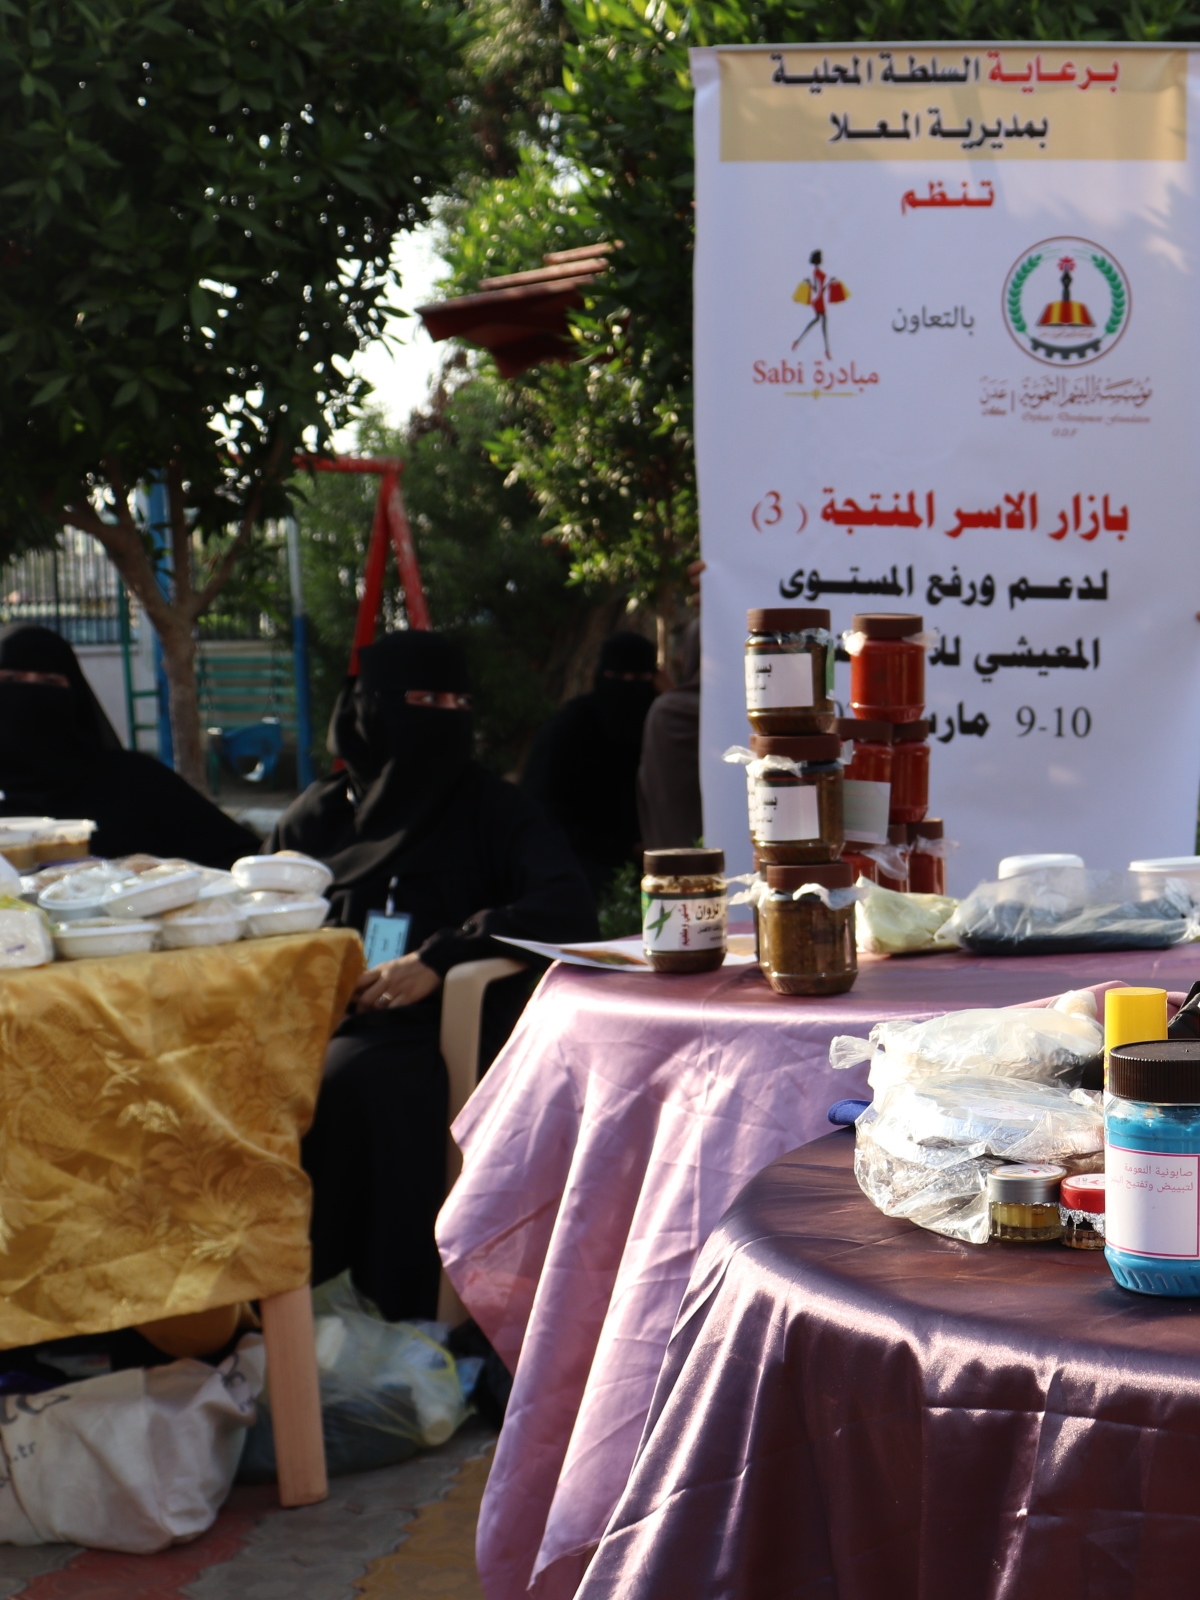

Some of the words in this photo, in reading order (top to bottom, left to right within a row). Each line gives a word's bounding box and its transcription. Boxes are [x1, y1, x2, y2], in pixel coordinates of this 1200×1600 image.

[771, 54, 873, 95] المحلية
[879, 53, 980, 85] السلطة
[987, 51, 1120, 93] برعاية
[828, 111, 920, 144] المعلا
[928, 107, 1049, 150] بمديرية
[900, 180, 996, 216] تنظم
[891, 305, 976, 336] بالتعاون
[752, 359, 804, 387] Sabi
[813, 359, 880, 391] مبادرة
[820, 486, 936, 535] المنتجة
[944, 490, 1038, 539] الاسر
[1049, 492, 1130, 541] بازار
[779, 564, 913, 601] المستوى
[925, 565, 996, 606] ورفع
[1008, 568, 1109, 609] لدعم
[973, 635, 1101, 684] المعيشي
[1124, 1163, 1151, 1176] النعومة
[1126, 1178, 1153, 1191] وتفتيح
[1155, 1167, 1193, 1179] صابونية
